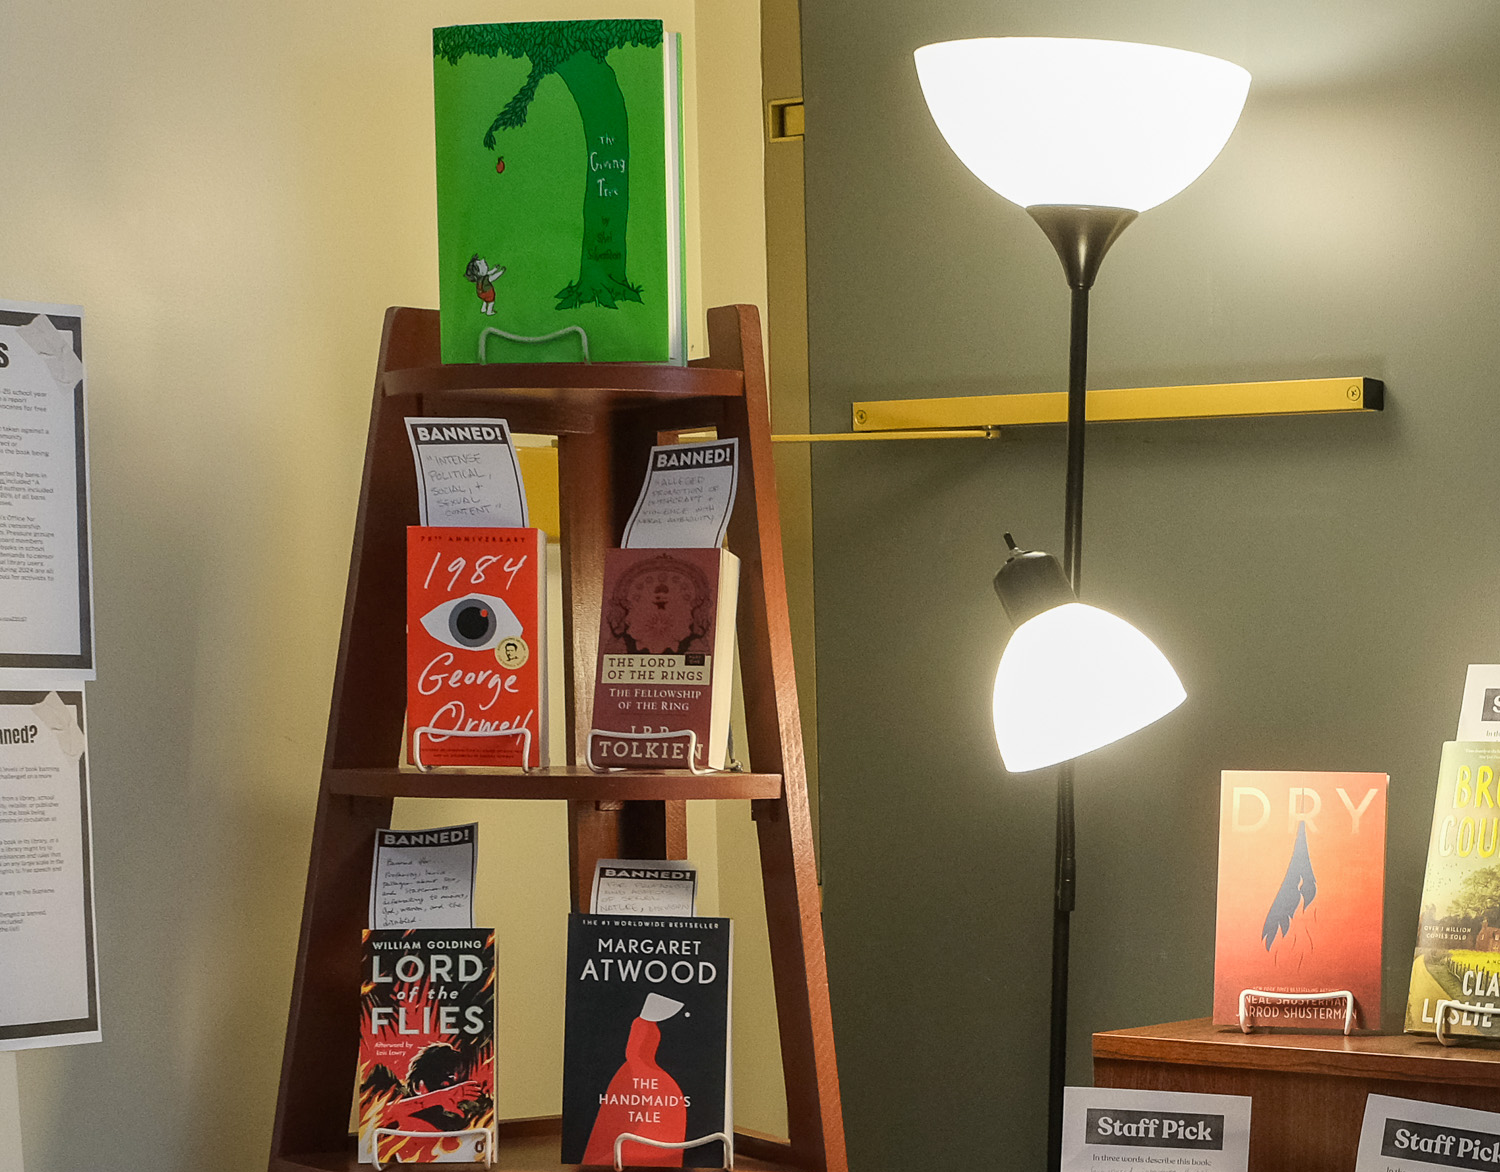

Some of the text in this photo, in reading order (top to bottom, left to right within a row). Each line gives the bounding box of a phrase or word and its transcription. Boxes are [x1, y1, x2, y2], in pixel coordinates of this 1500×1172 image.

[416, 426, 503, 442] BANNED!
[656, 447, 731, 468] BANNED!
[423, 552, 528, 592] 1984
[608, 657, 635, 668] THE
[640, 658, 676, 668] LORD
[417, 652, 519, 711] George
[607, 670, 703, 681] OF THE RINGS
[599, 741, 704, 761] TOLKIEN
[1231, 786, 1379, 835] DRY
[383, 828, 470, 846] BANNED!
[372, 940, 483, 951] WILLIAM GOLDING
[597, 938, 702, 956] MARGARET
[372, 954, 484, 983] LORD
[579, 958, 718, 985] ATWOOD
[396, 985, 460, 1003] of the
[371, 1005, 485, 1035] FLIES
[632, 1078, 659, 1090] THE
[598, 1093, 692, 1108] HANDMAID'S
[627, 1111, 661, 1123] TALE
[1097, 1115, 1213, 1141] Staff Pick
[1394, 1128, 1456, 1157] Staff
